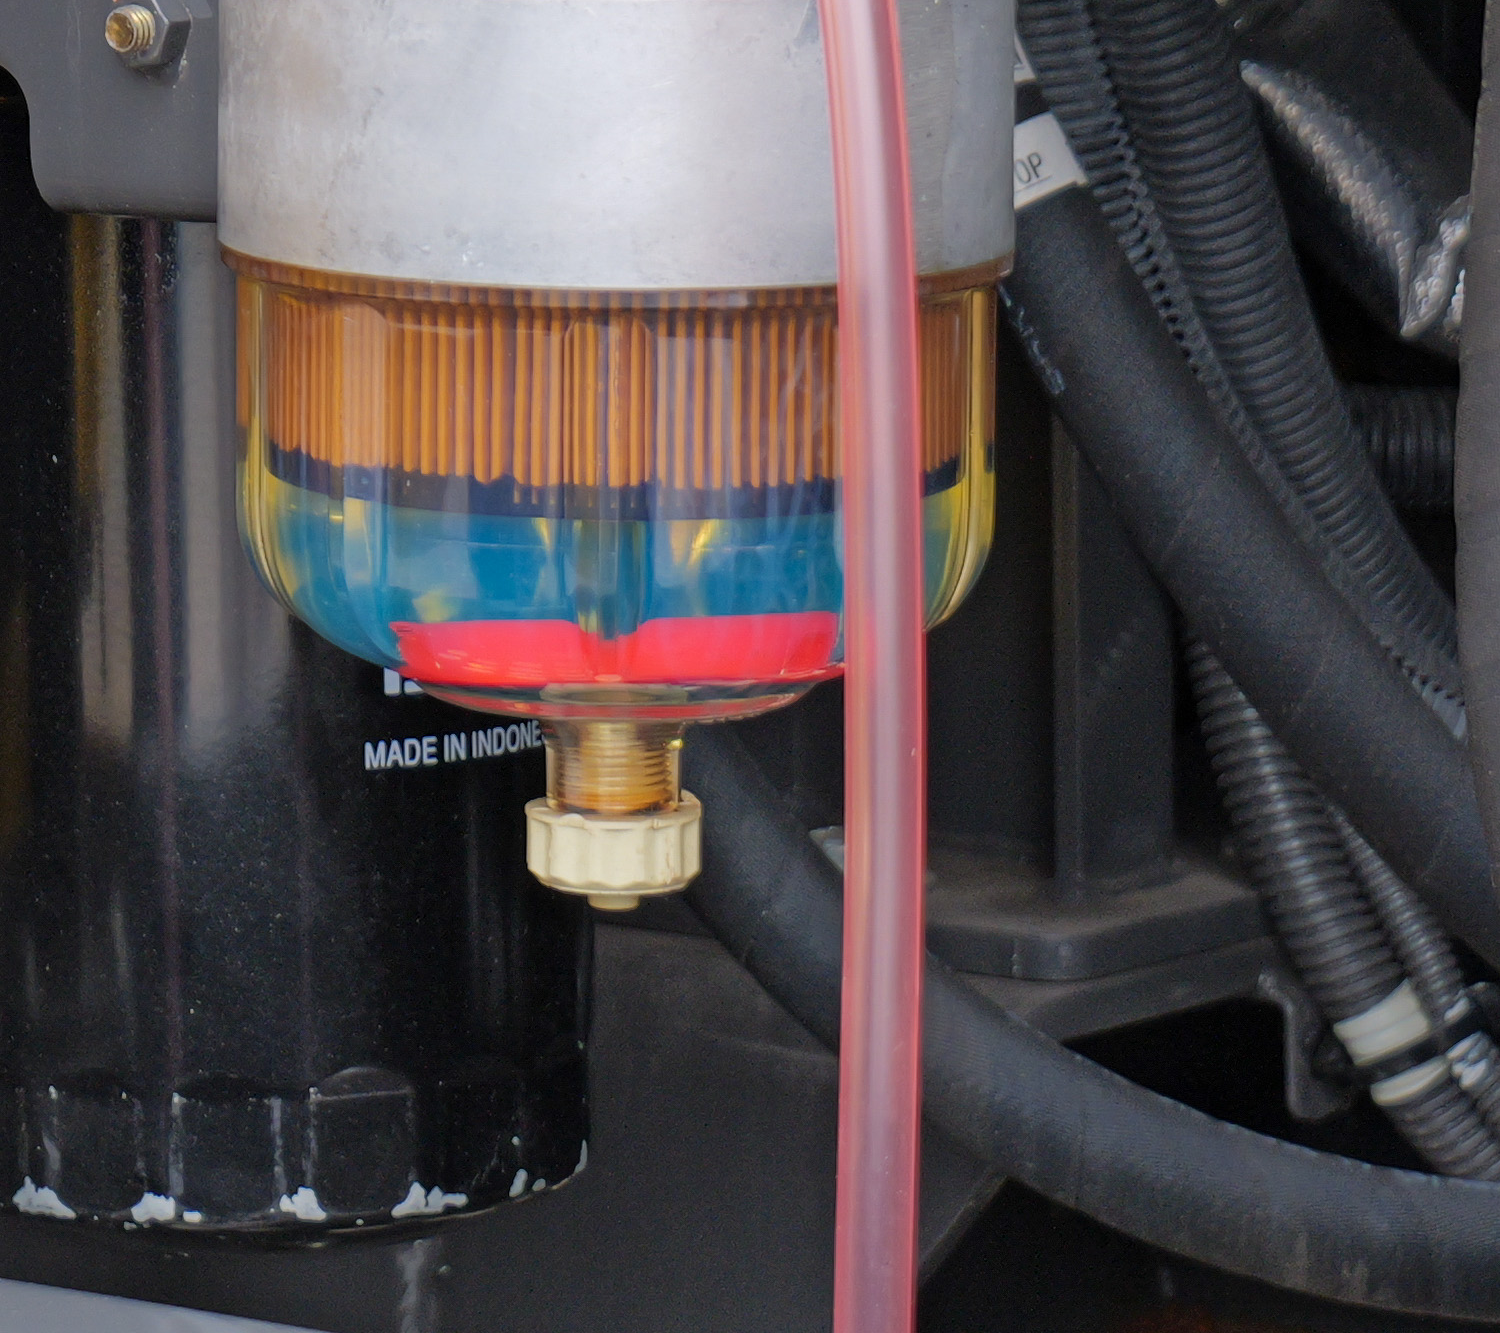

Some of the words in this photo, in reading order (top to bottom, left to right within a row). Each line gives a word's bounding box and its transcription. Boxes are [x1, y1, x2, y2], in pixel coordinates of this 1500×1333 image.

[363, 734, 440, 771] MADE
[443, 731, 468, 763] IN
[471, 719, 546, 759] INDONE
